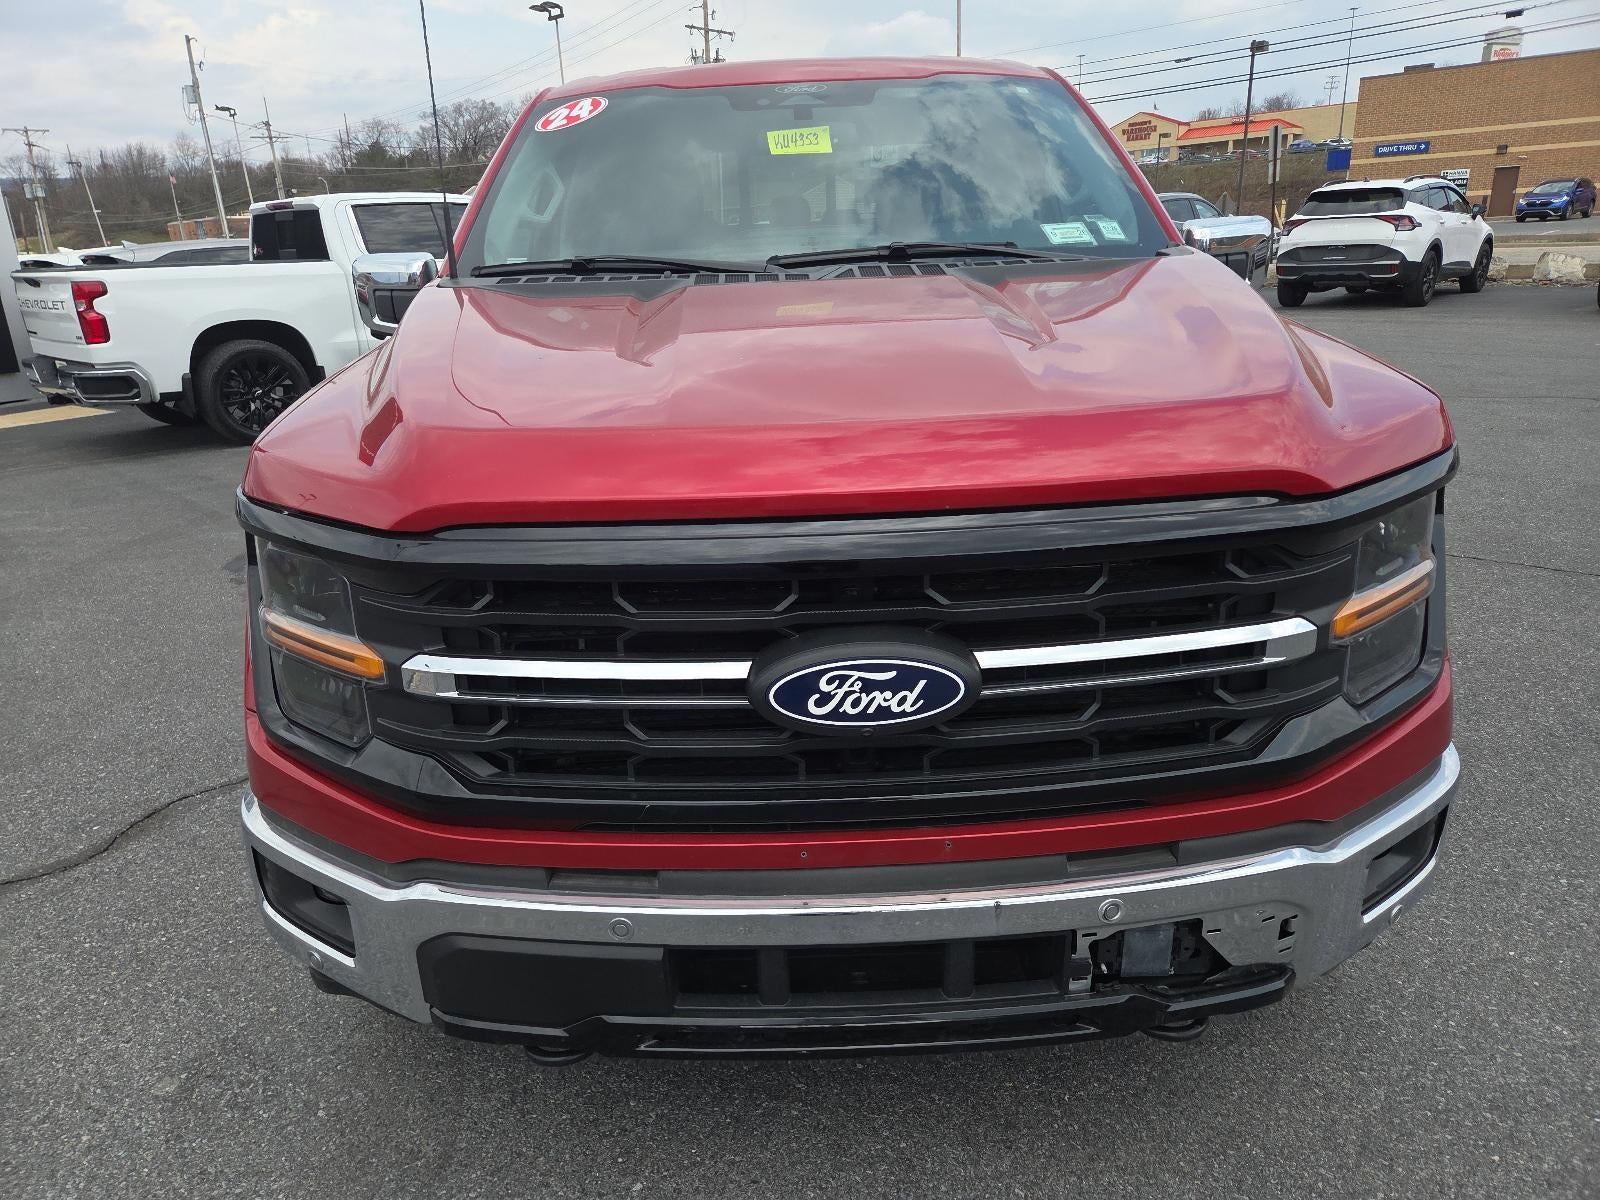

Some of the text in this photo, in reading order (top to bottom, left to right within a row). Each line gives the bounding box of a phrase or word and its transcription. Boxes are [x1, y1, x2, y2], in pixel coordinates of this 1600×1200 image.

[545, 98, 595, 129] 24
[1122, 125, 1158, 135] WAREHOUSE
[1126, 133, 1151, 142] MARKET
[1378, 144, 1417, 153] DRIVE THRU
[807, 670, 928, 715] Ford
